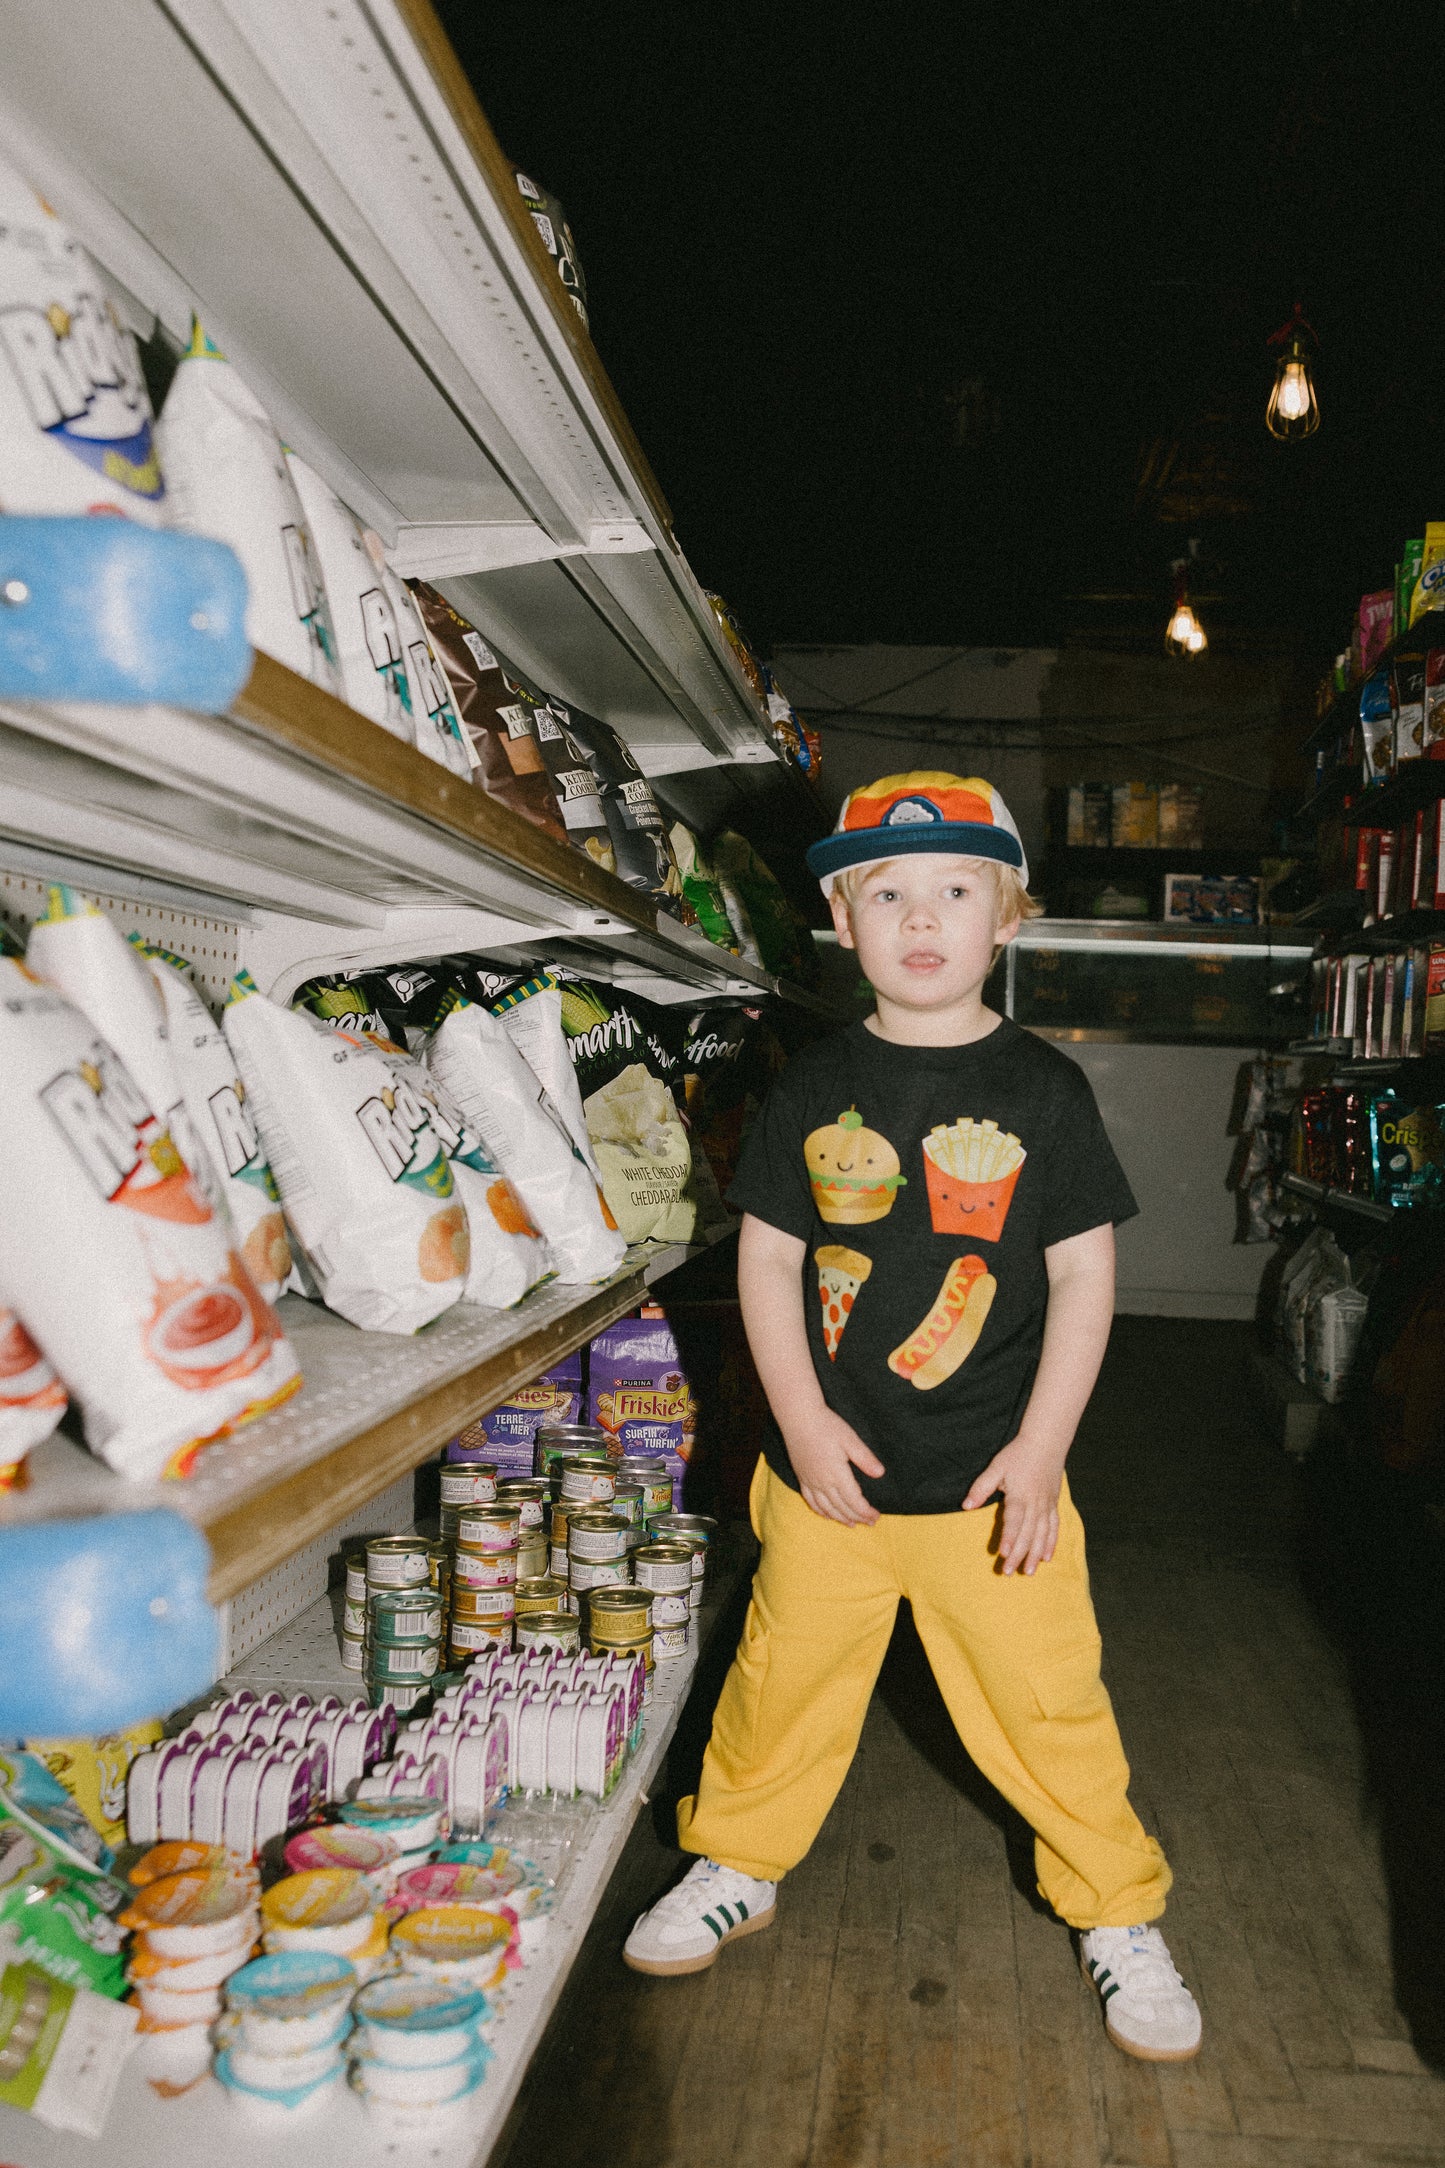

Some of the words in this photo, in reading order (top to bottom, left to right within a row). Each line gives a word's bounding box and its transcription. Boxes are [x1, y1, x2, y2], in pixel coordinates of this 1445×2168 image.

[621, 1166, 653, 1181] WHITE
[630, 1189, 671, 1207] CHEDDAR
[623, 1379, 651, 1387] PURINA
[620, 1394, 686, 1417] Friskies
[495, 1414, 524, 1425] TERRE
[509, 1425, 530, 1436] MER
[644, 1437, 679, 1449] TURFIN'
